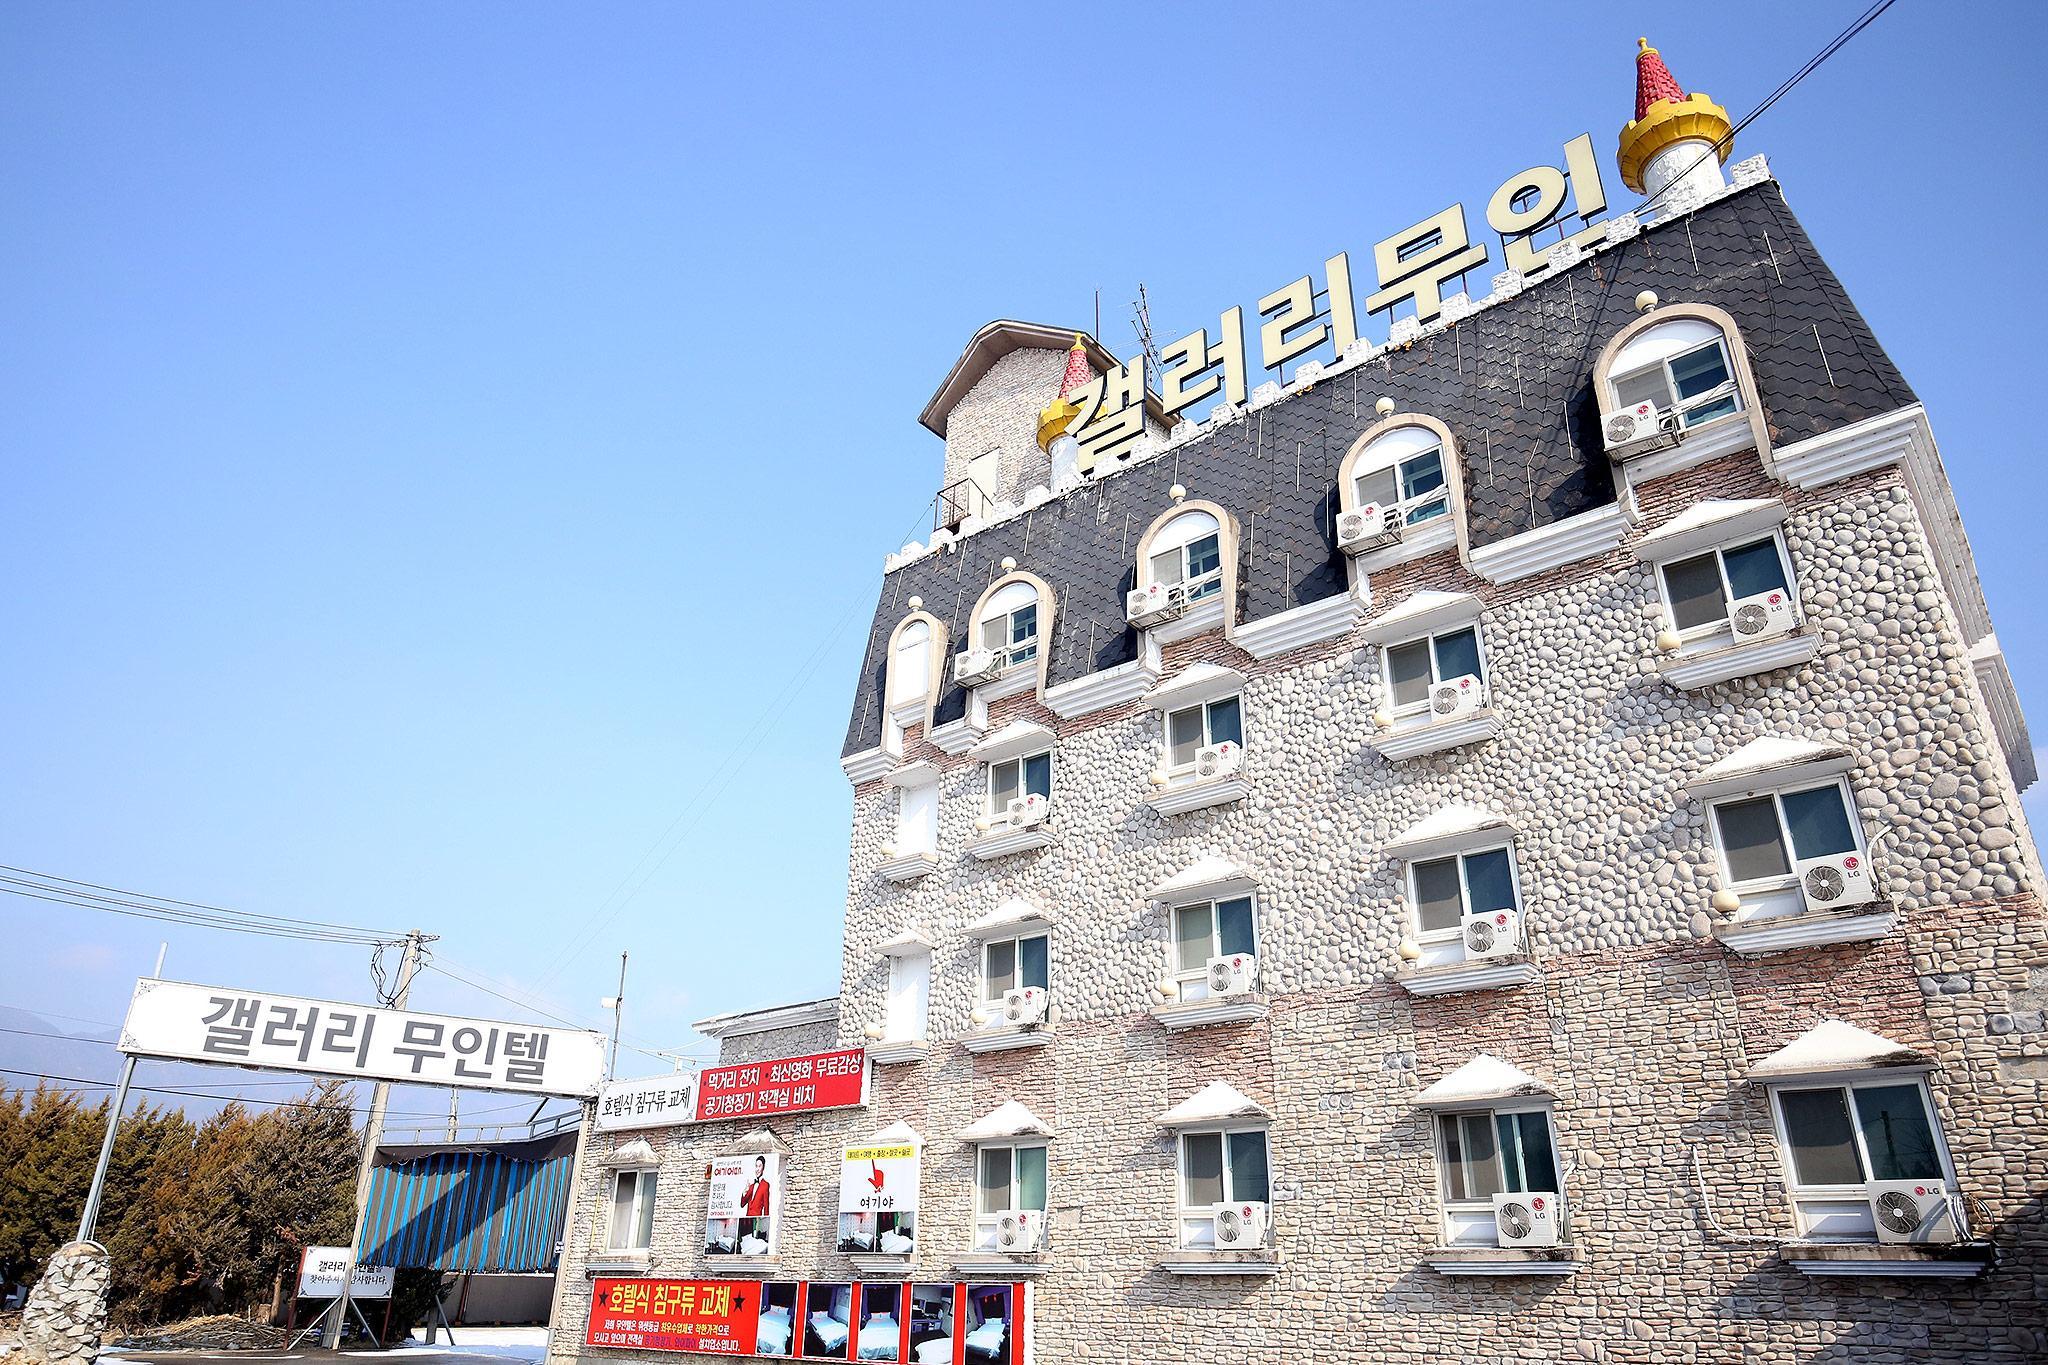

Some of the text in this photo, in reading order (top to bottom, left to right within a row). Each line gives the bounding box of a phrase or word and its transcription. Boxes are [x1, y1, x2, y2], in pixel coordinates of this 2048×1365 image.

[200, 996, 550, 1085] 갤러리 무인텔
[708, 1054, 862, 1091] 먹거리 잔치 최신영화 무료감상
[602, 1085, 691, 1117] 호텔식 침구류 교체
[704, 1084, 817, 1116] 공기청정기 전객실 비치
[860, 1195, 894, 1209] 여기야
[318, 1260, 347, 1272] 갤러리
[608, 1283, 731, 1318] 호텔식 침구류 교체
